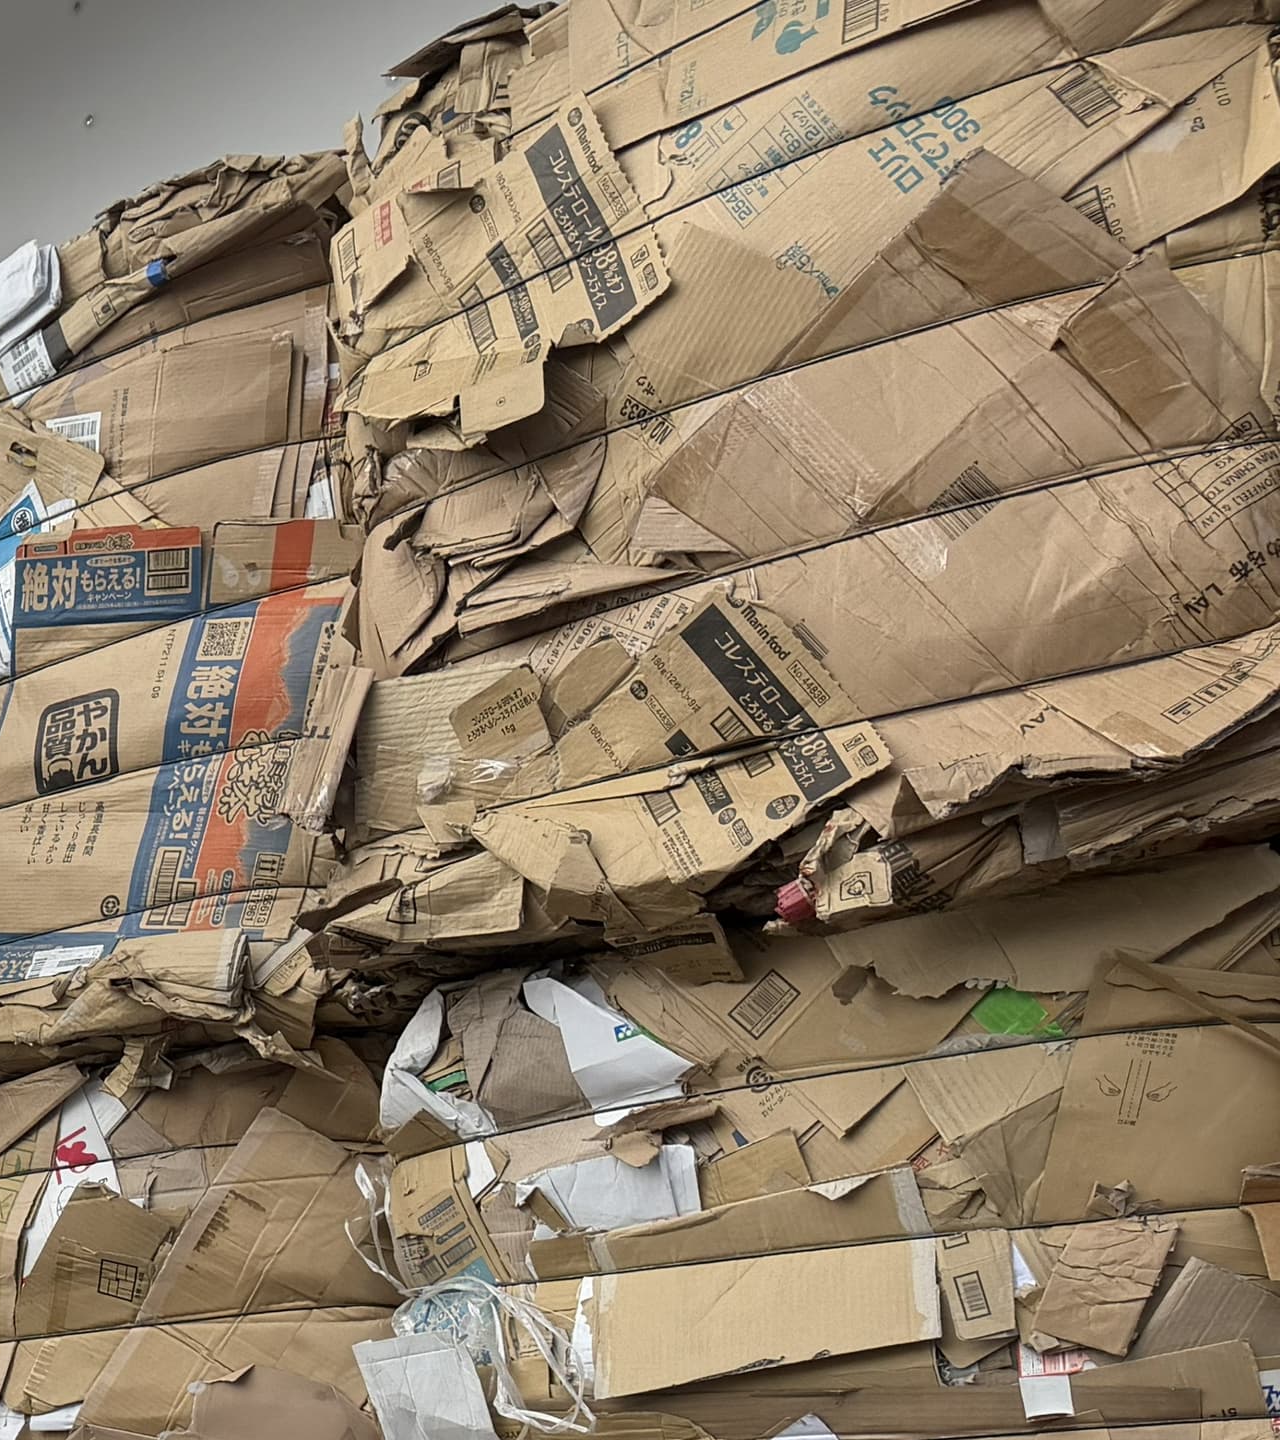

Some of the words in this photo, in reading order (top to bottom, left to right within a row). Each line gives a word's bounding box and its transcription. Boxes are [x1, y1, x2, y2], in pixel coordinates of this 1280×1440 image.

[20, 559, 80, 613] 絶対
[81, 567, 140, 593] もらえる!
[87, 591, 133, 602] キャンペーン
[739, 604, 771, 641] Marin
[763, 633, 792, 662] food
[180, 665, 239, 739] 絶対
[789, 661, 829, 706] No.44838
[44, 706, 77, 761] 品質
[75, 701, 109, 780] やかん
[44, 801, 68, 865] しているから
